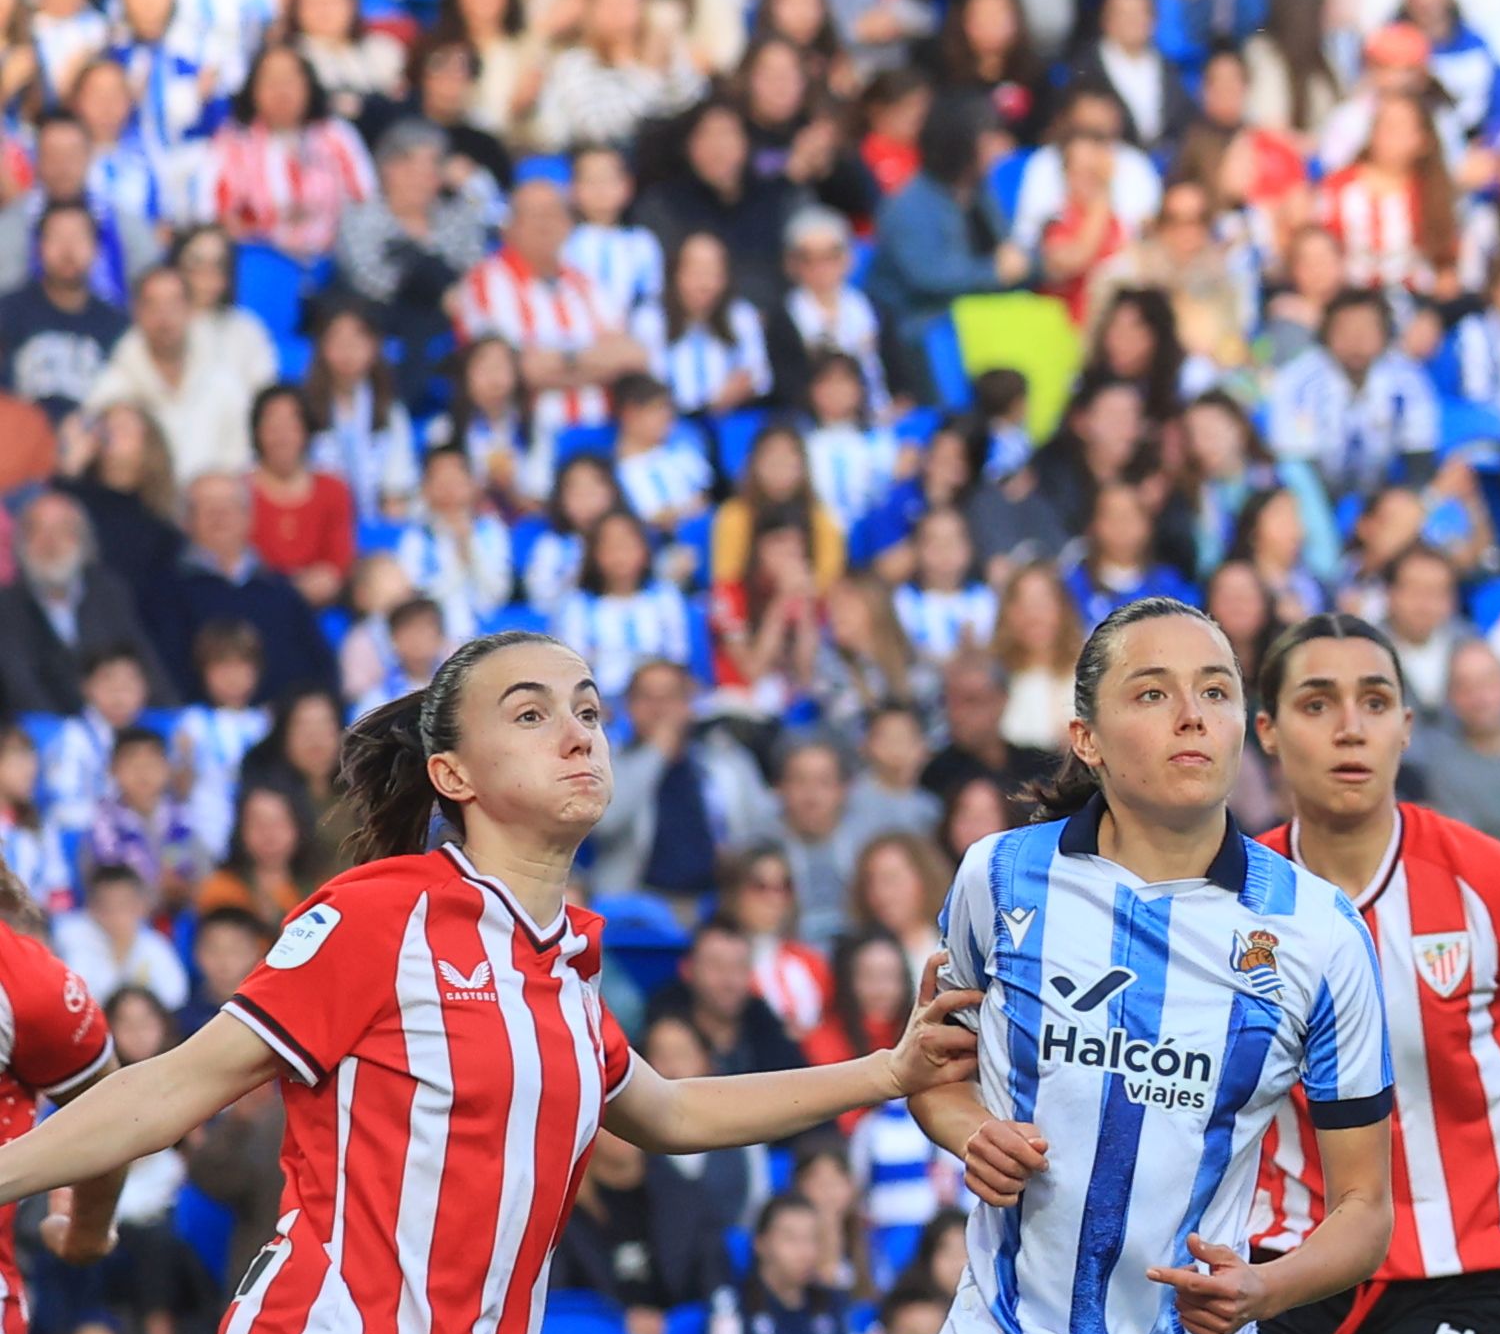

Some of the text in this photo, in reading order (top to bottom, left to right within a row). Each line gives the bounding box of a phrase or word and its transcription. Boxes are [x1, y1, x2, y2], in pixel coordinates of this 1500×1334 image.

[445, 991, 497, 1002] CASTORE
[1042, 1024, 1212, 1083] Halcón
[1128, 1079, 1205, 1109] viajes
